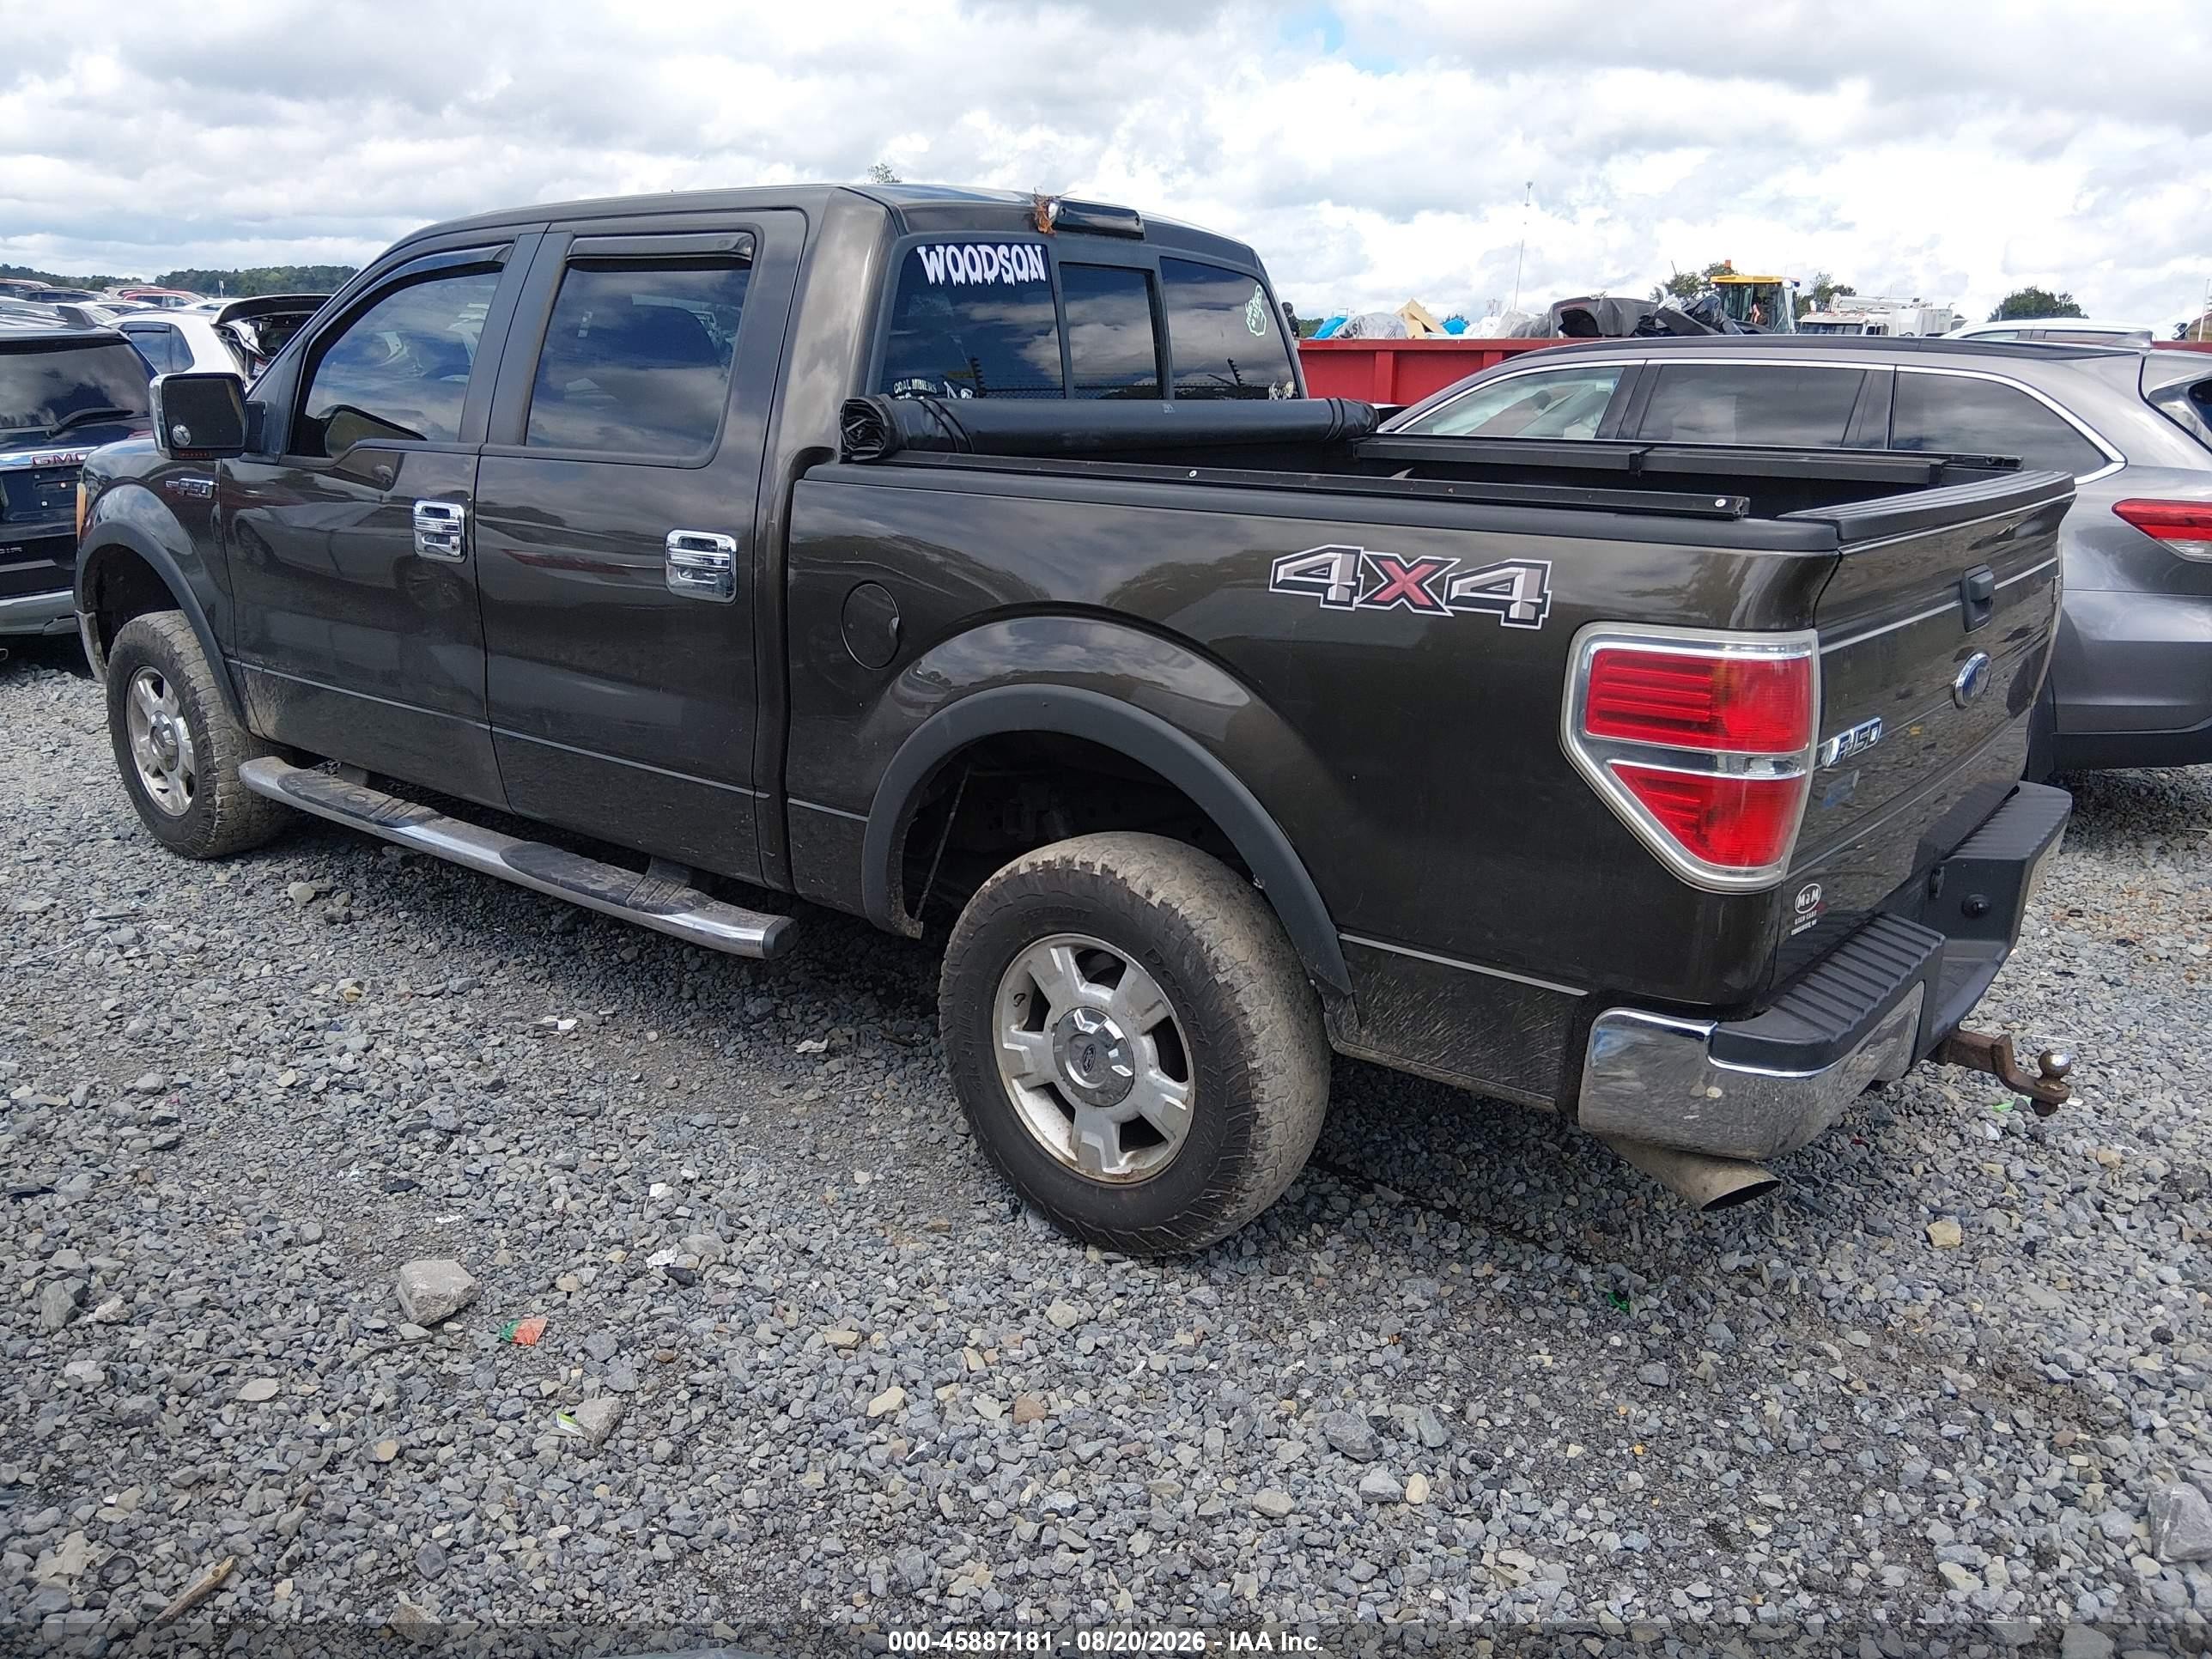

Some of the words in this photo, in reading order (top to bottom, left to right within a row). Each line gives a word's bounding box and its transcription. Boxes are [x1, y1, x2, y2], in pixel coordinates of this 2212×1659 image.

[916, 244, 1046, 287] WOODSON
[894, 379, 911, 394] COAL
[911, 379, 937, 394] MINERS
[31, 452, 89, 466] GMC
